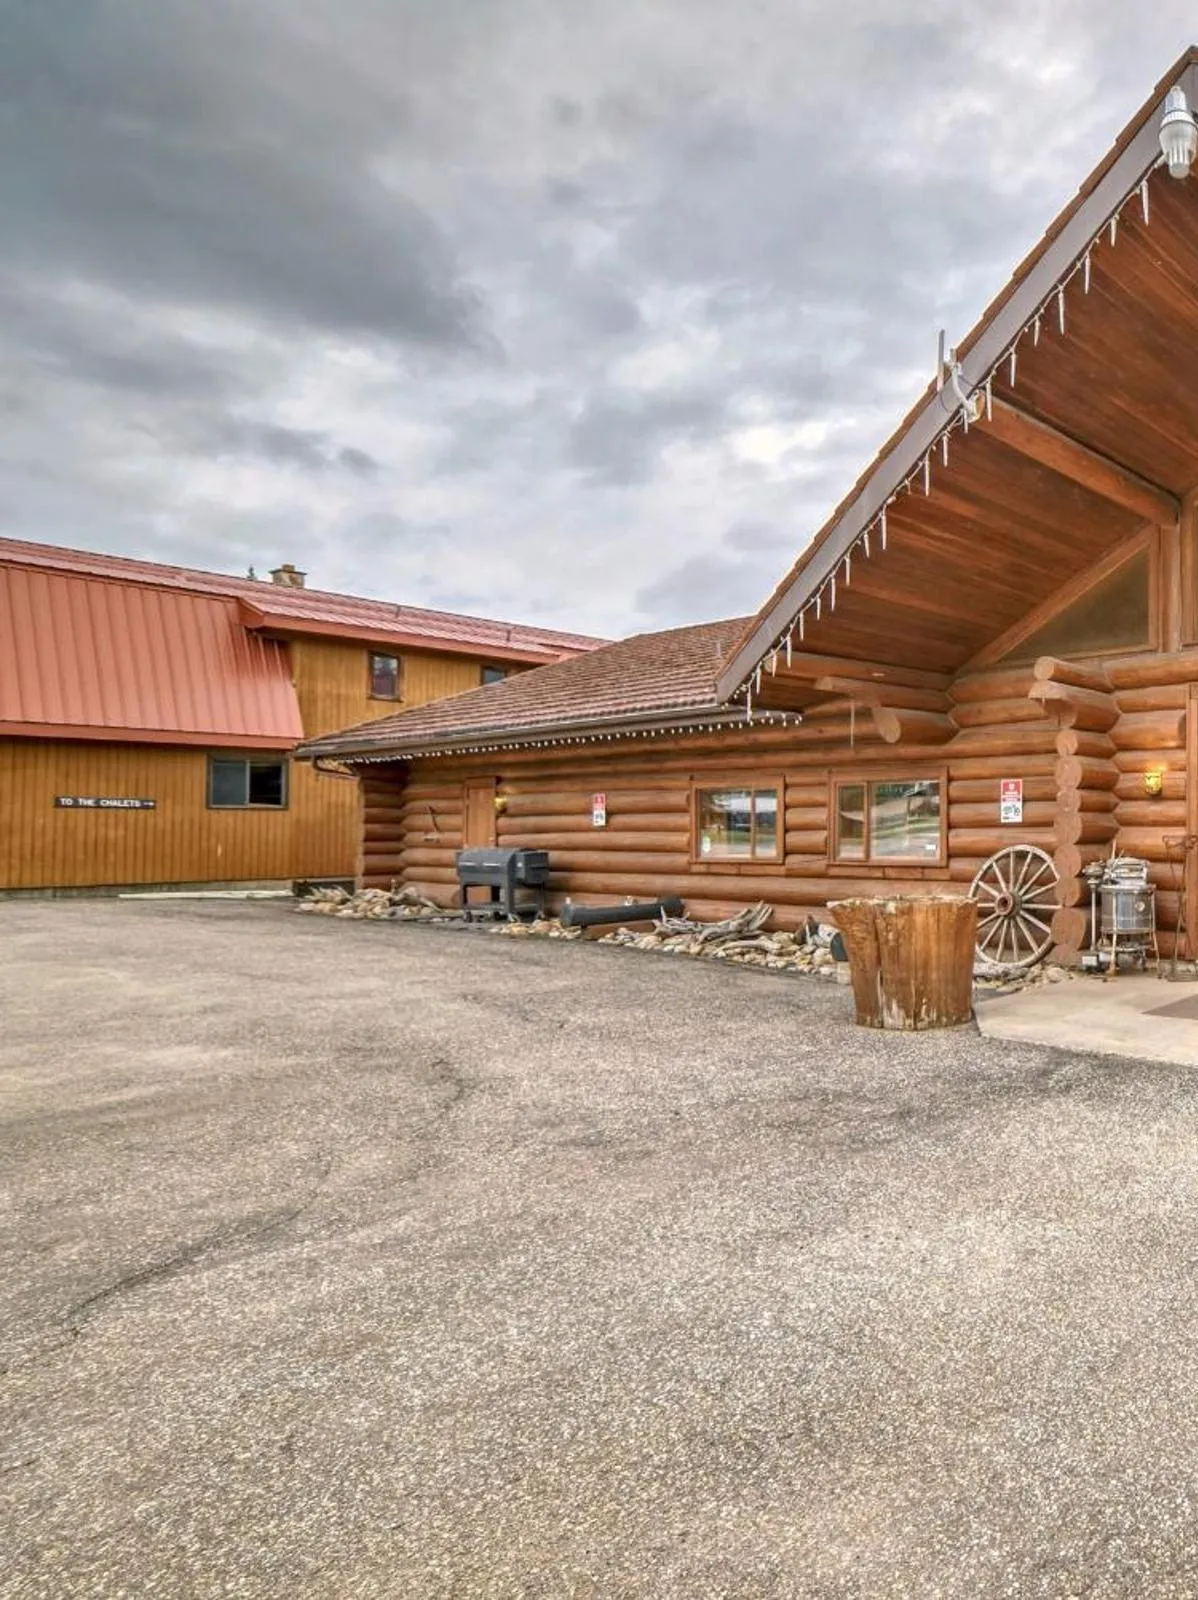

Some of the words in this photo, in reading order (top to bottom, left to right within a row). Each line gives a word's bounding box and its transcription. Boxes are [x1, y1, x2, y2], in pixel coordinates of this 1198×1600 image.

[60, 797, 73, 806] TO
[79, 798, 96, 807] THE
[100, 799, 141, 807] CHALETS
